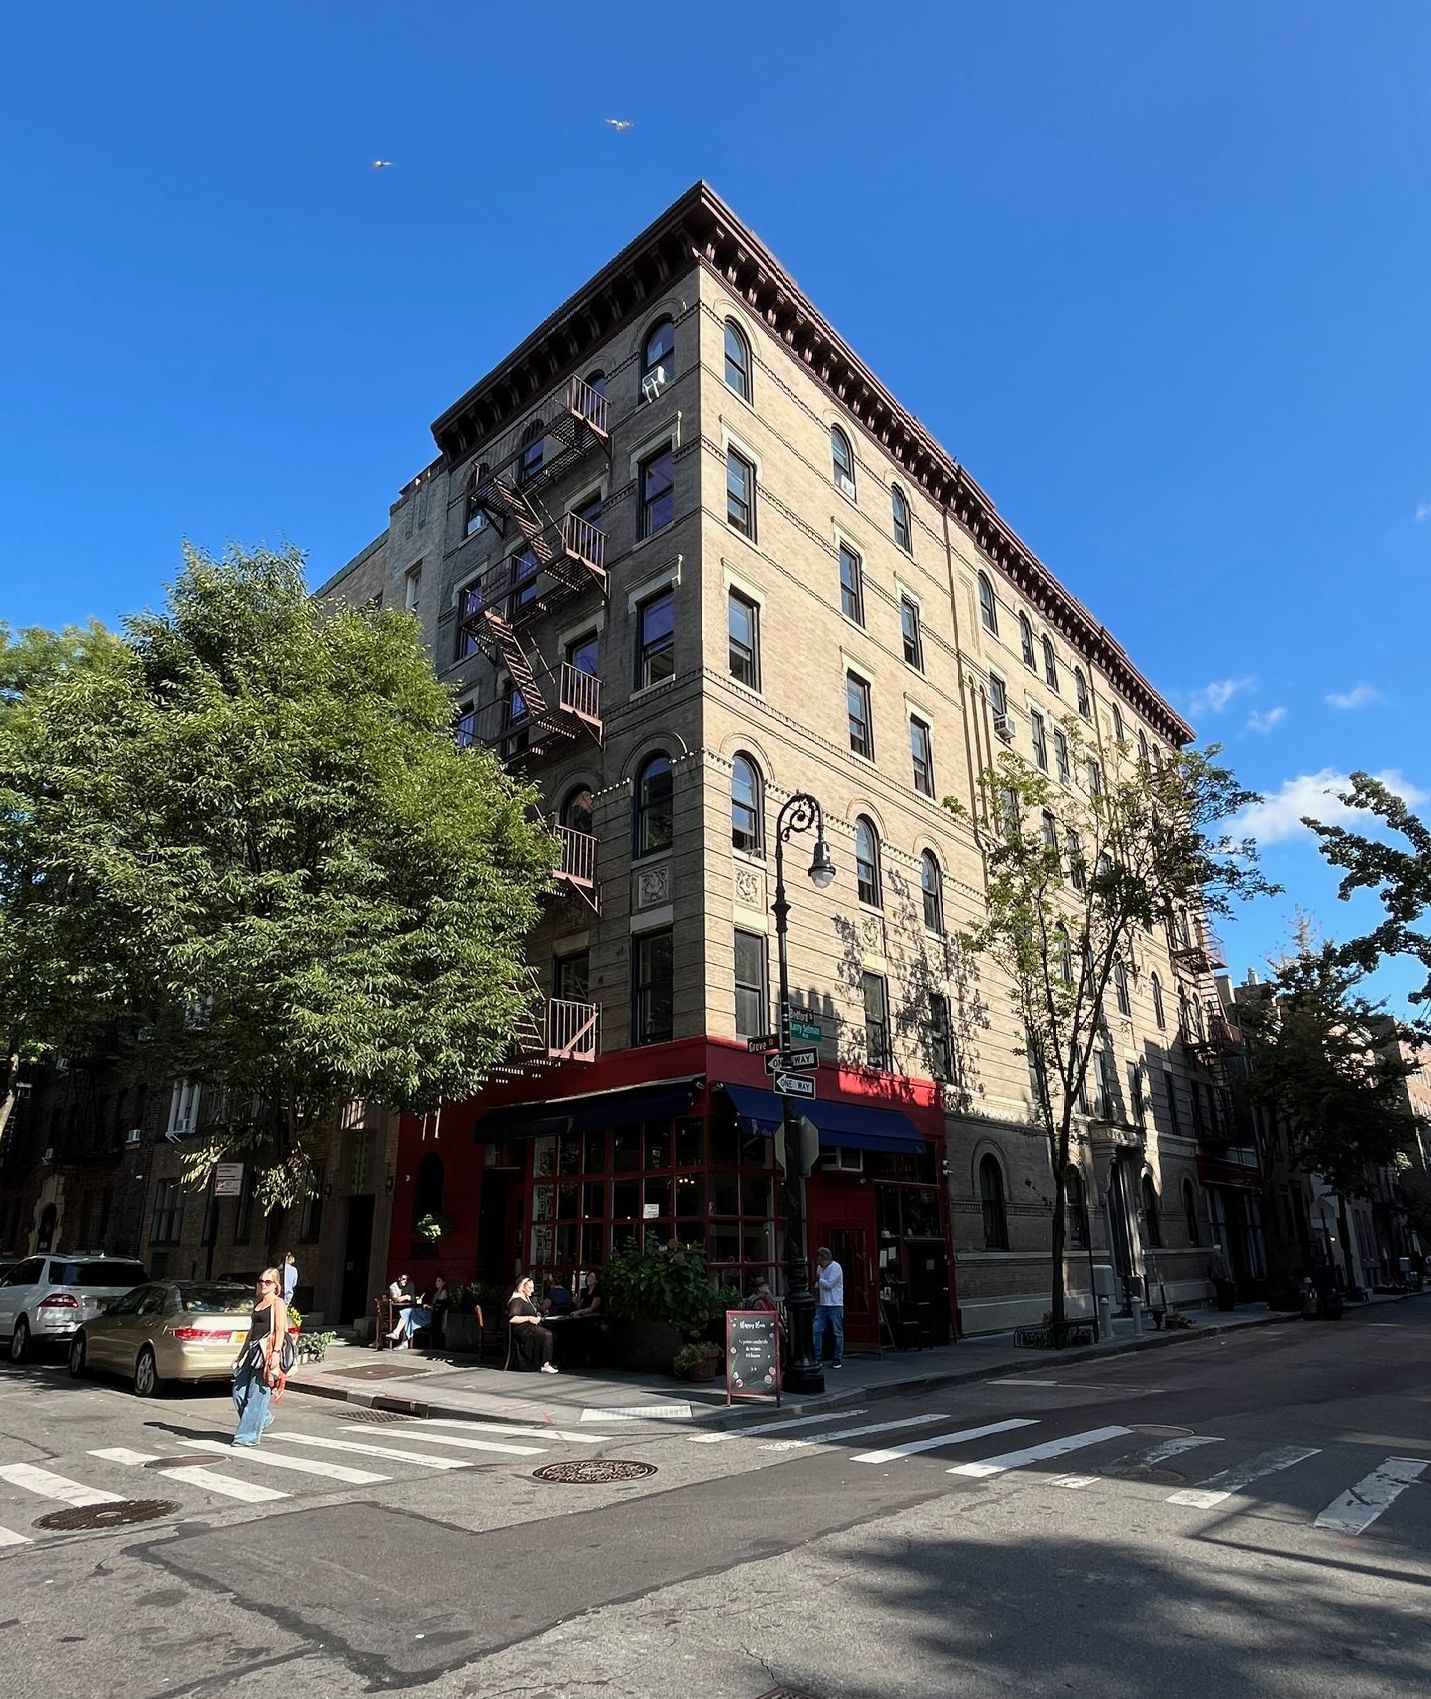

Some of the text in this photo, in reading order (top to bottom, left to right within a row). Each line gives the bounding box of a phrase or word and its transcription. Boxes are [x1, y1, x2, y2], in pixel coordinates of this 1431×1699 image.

[749, 1041, 767, 1053] Grove
[795, 1055, 811, 1065] WAY
[781, 1079, 810, 1091] ONE WAY
